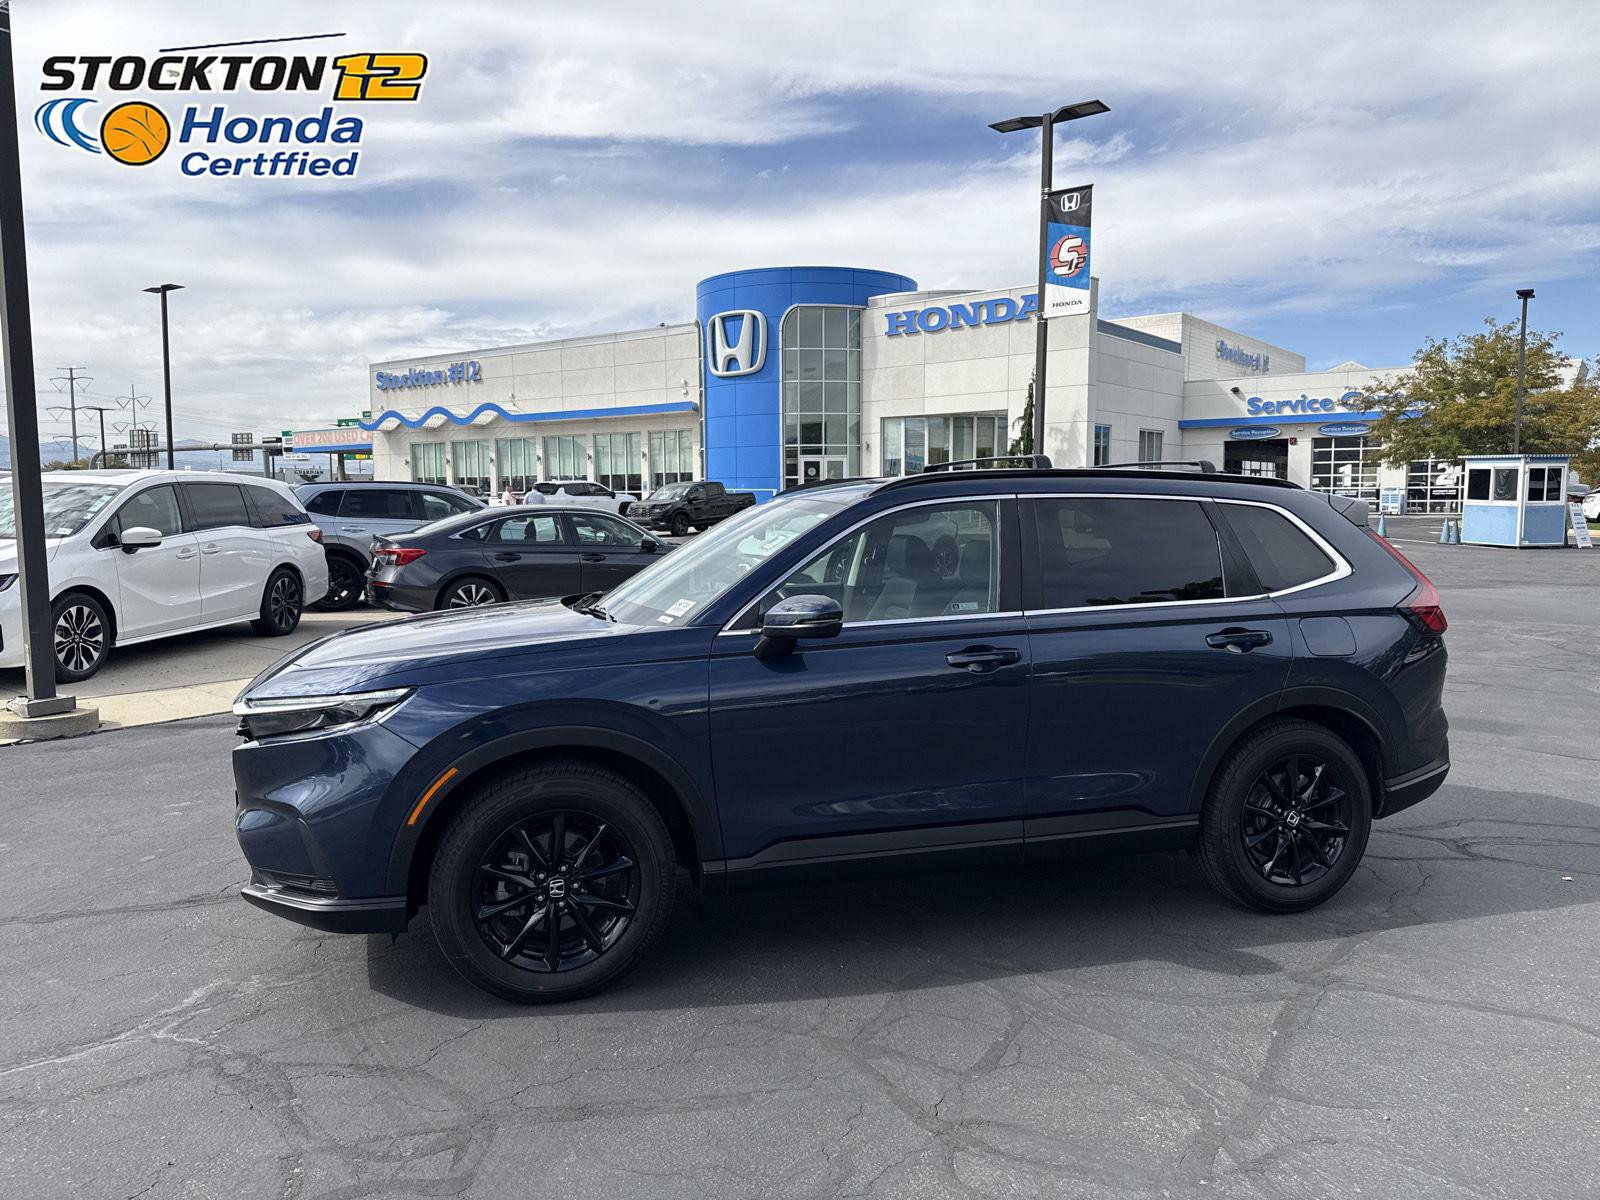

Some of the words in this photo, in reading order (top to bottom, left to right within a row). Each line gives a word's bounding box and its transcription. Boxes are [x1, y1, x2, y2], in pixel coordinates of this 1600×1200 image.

[1052, 299, 1083, 308] HONDA
[885, 293, 1038, 336] HONDA
[376, 368, 443, 391] Stockton
[448, 360, 482, 384] #12
[1247, 394, 1334, 415] Service
[293, 431, 316, 445] OVER
[335, 430, 358, 442] USED
